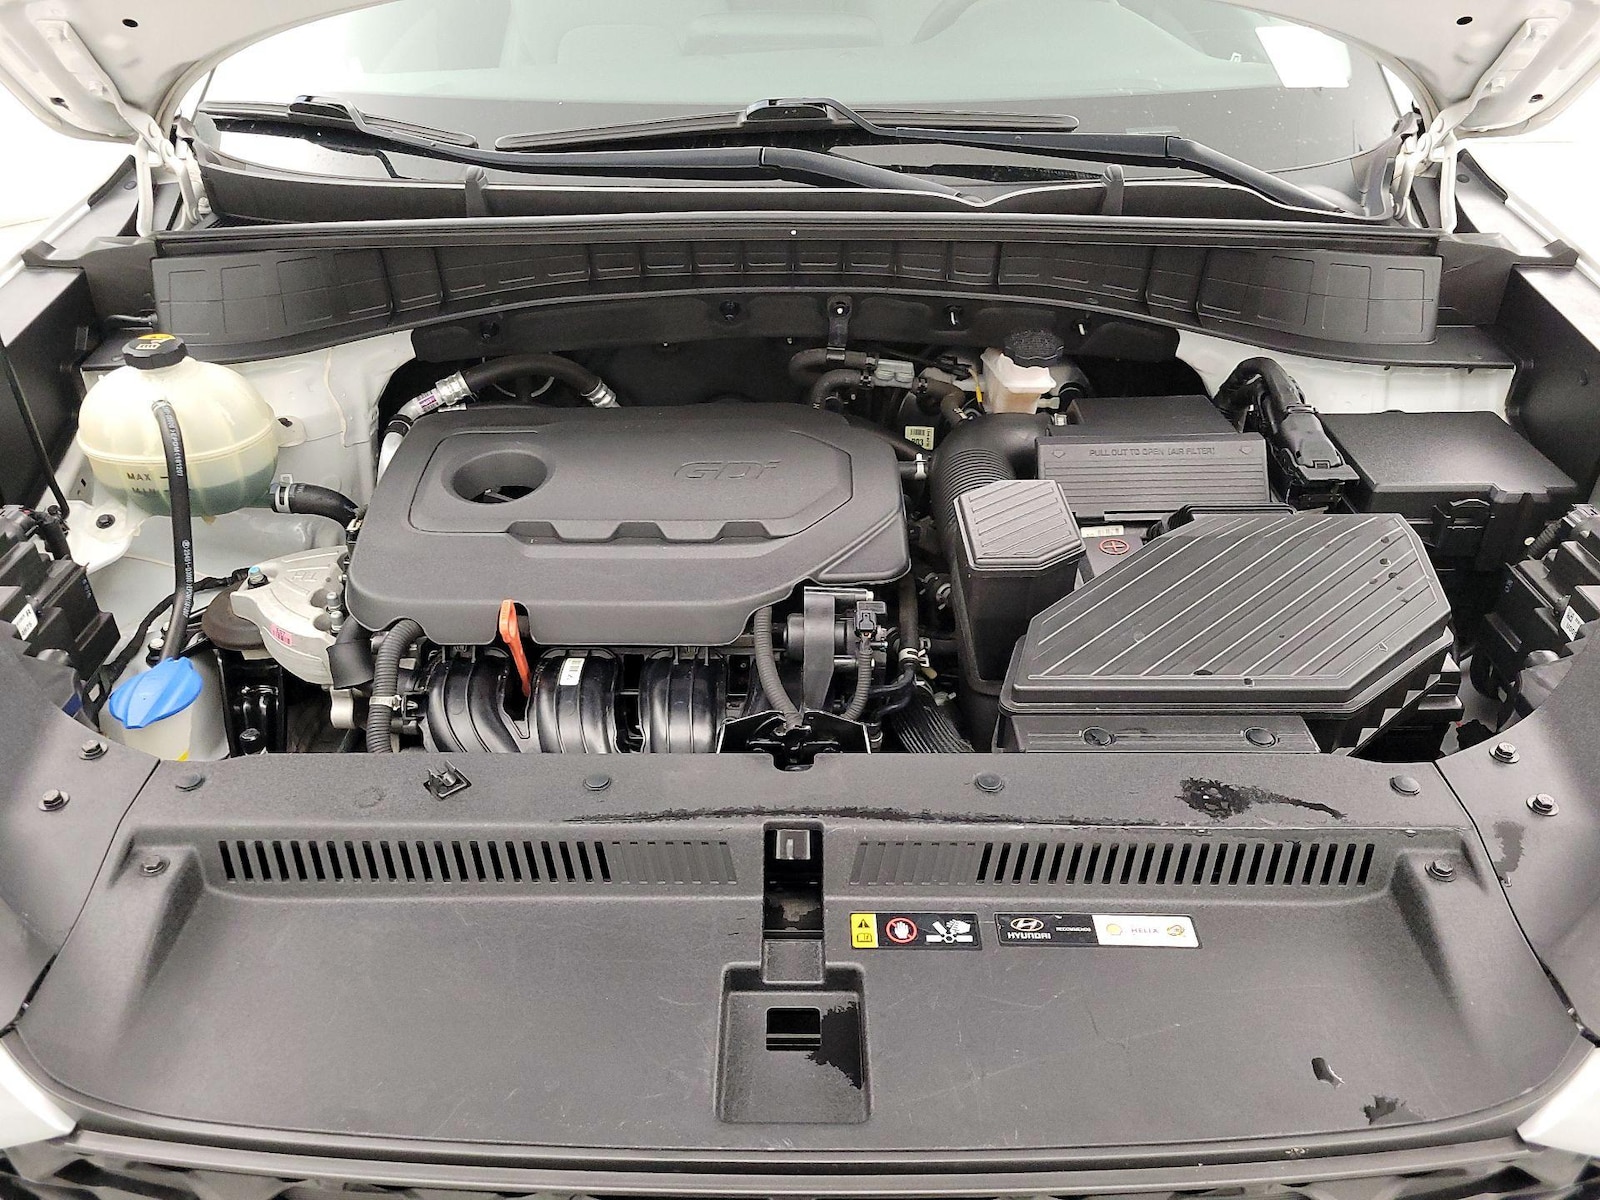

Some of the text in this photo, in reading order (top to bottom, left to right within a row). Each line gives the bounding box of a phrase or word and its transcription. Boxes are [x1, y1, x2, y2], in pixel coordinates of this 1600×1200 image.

[1089, 449, 1110, 457] PULL
[1111, 448, 1129, 456] OUT
[1130, 448, 1140, 456] TO
[1142, 448, 1164, 456] OPEN
[126, 472, 152, 481] MAX
[1007, 932, 1052, 940] HYUNDAI
